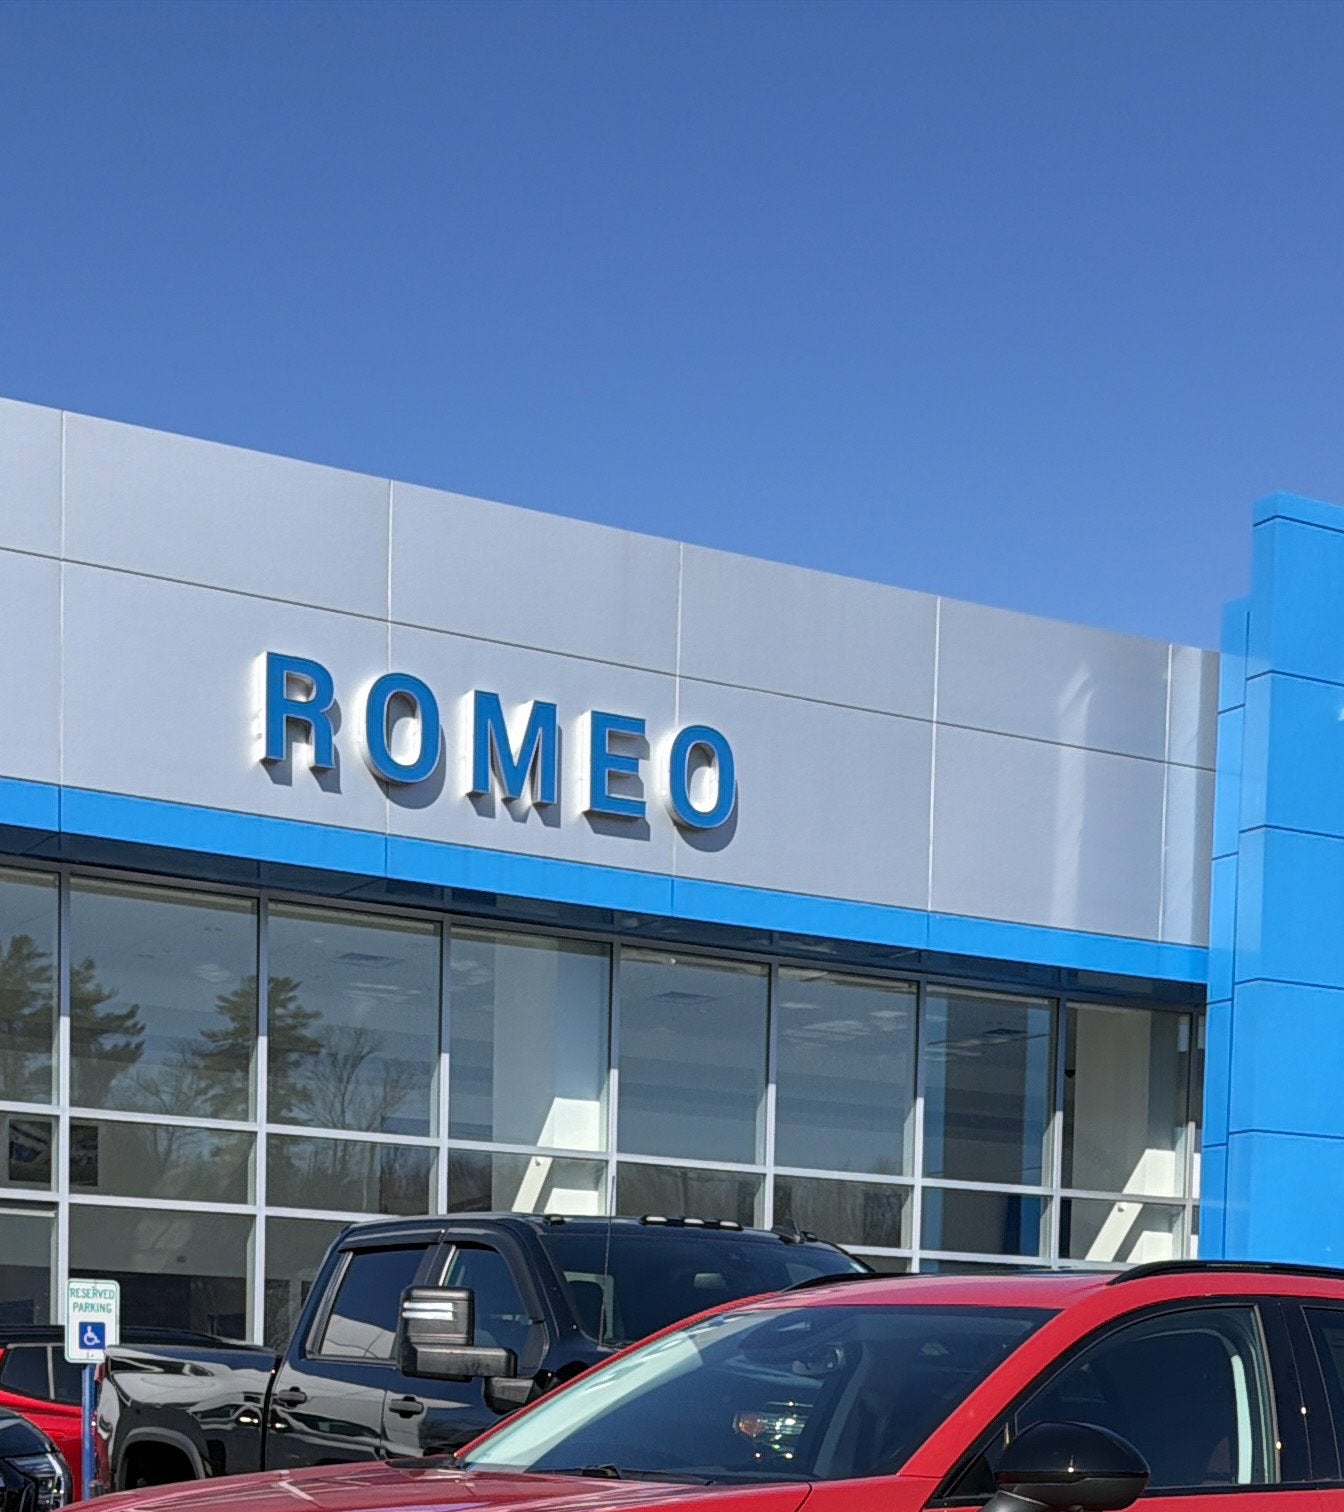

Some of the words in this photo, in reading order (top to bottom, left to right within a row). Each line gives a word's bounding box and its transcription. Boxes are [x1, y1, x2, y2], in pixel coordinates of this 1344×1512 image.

[260, 650, 737, 830] ROMEO
[69, 1287, 115, 1300] RESERVED
[72, 1301, 113, 1313] PARKING
